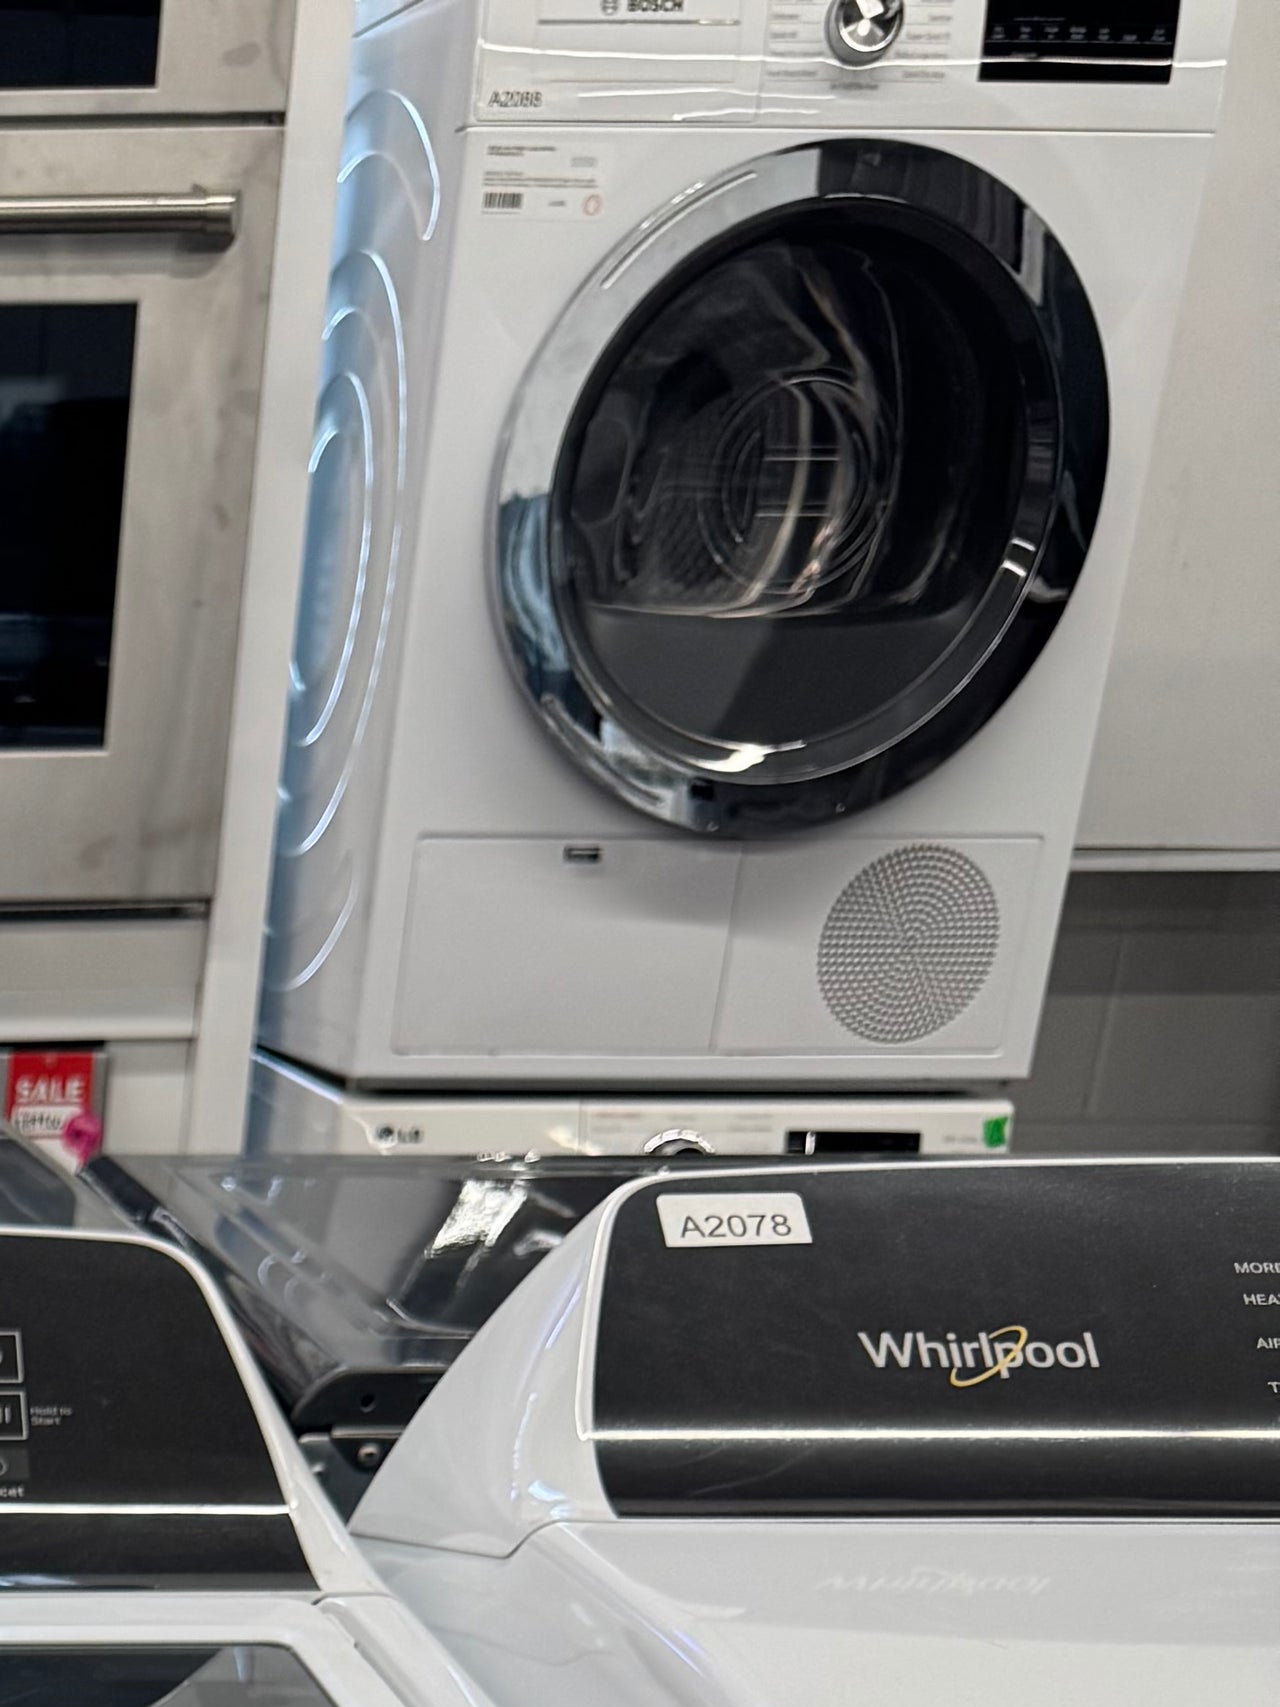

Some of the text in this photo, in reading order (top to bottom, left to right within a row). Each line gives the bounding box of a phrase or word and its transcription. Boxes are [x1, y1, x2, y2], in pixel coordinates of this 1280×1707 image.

[15, 1074, 85, 1104] SALE
[680, 1213, 793, 1239] A2078
[857, 1327, 1100, 1386] Whirlpool
